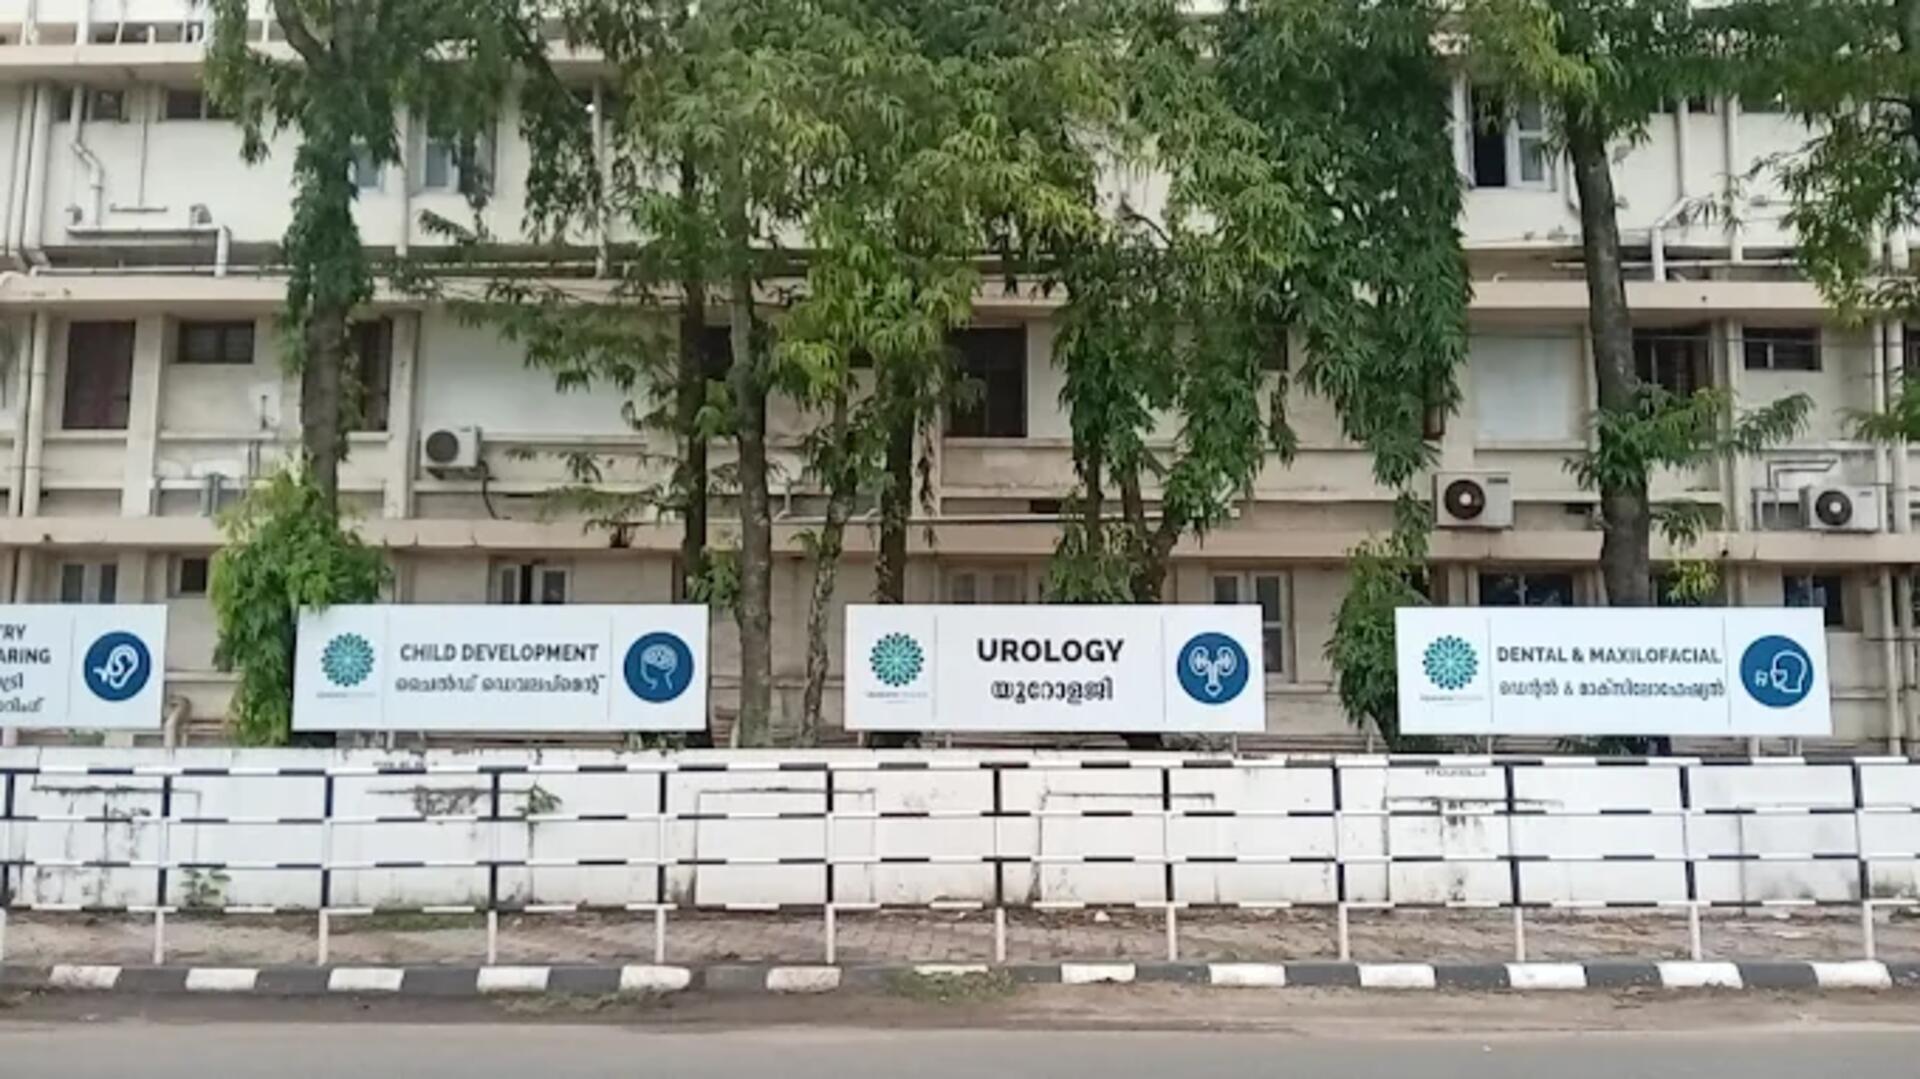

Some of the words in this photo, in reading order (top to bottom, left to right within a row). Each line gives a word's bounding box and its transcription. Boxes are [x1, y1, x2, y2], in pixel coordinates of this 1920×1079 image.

[400, 643, 457, 661] CHILD
[462, 643, 598, 661] DEVELOPMENT
[977, 638, 1124, 662] UROLOGY
[1497, 646, 1568, 662] DENTAL
[1572, 646, 1585, 662] &
[1590, 647, 1722, 663] MAXILOFACIAL
[1564, 681, 1574, 695] &
